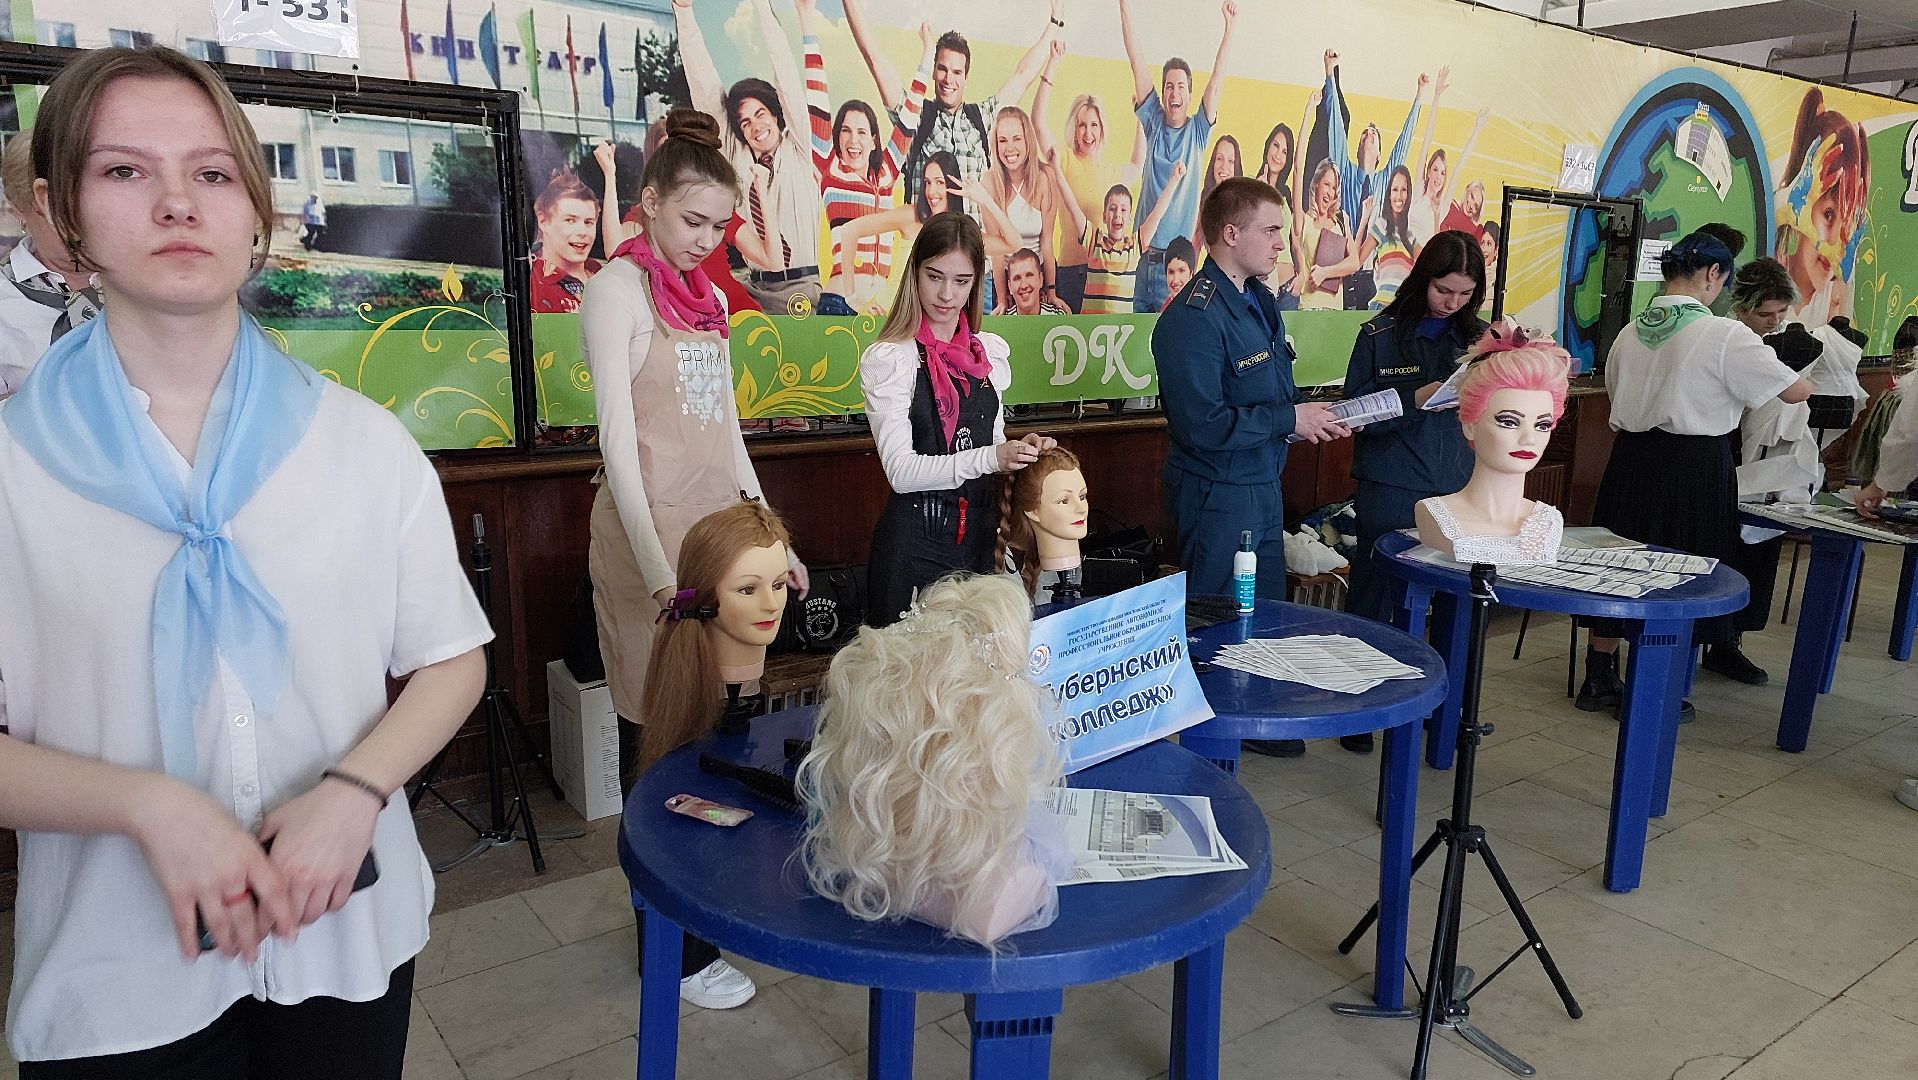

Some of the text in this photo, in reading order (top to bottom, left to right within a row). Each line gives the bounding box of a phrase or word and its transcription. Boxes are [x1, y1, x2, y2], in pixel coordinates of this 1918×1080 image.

[1379, 366, 1420, 376] МЧС РОССИИ
[1058, 613, 1172, 659] ПРОФЕССИОНАЛЬНОЕ ОБРАЗОВАТЕЛЬНОЕ
[1068, 606, 1164, 646] ГОСУДАРСТВЕННОЕ АВТОНОМНОЕ
